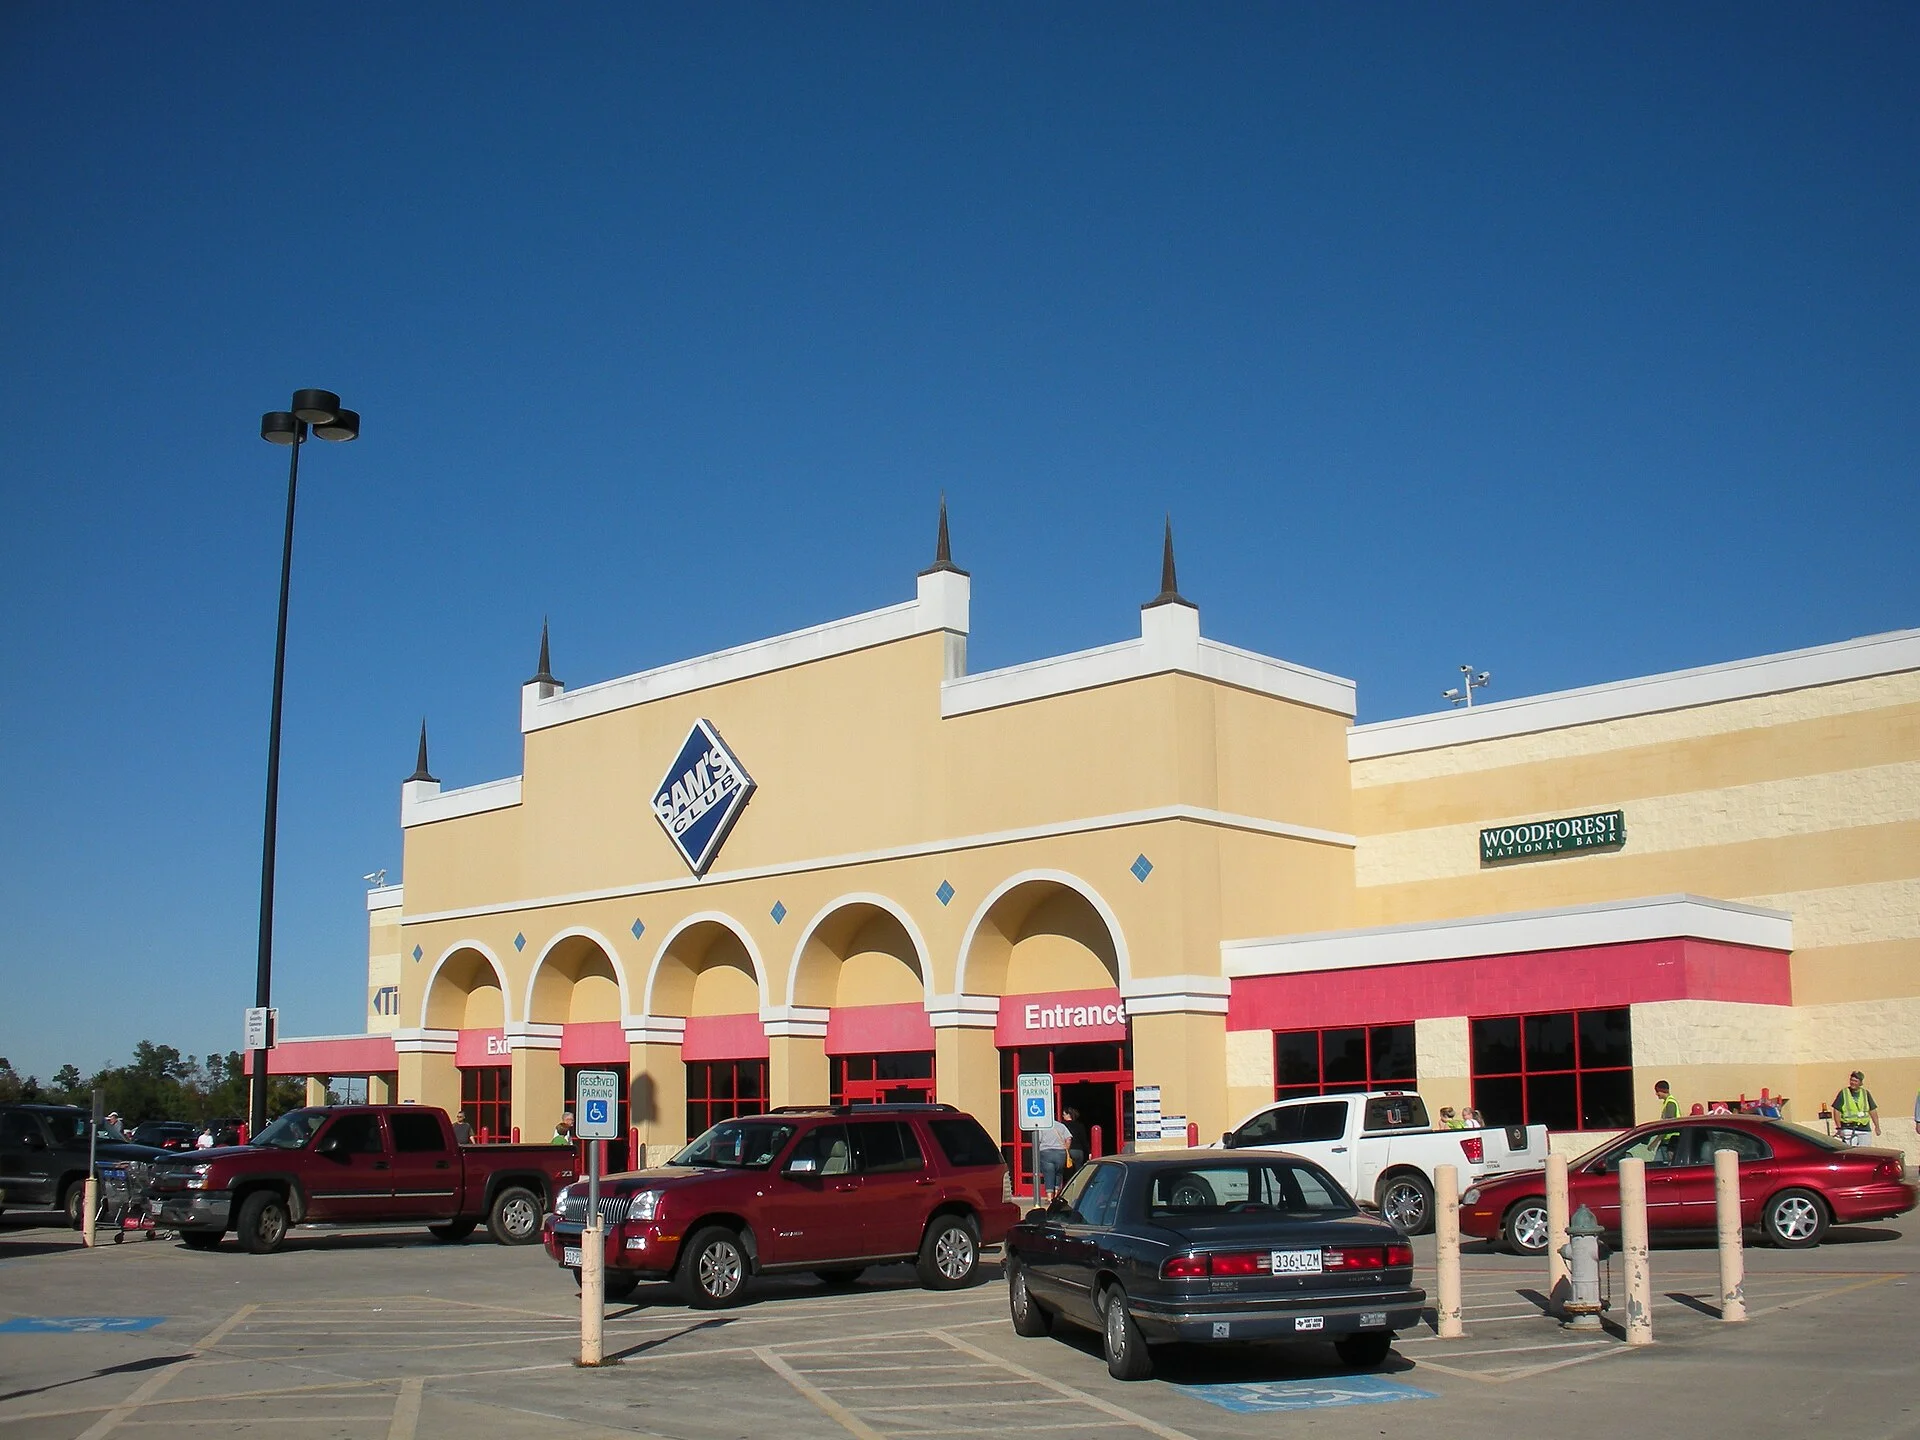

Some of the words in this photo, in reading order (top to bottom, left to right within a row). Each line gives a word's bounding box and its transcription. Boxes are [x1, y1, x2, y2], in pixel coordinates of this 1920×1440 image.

[656, 747, 728, 825] SAM'S
[673, 771, 736, 834] CLUB
[1482, 813, 1618, 848] WOODFOREST
[1485, 841, 1563, 858] NATIONAL
[1576, 832, 1616, 846] BANK
[381, 986, 400, 1015] Ti
[1025, 1003, 1126, 1030] Entrance
[580, 1077, 615, 1087] RESERVED
[582, 1088, 613, 1098] PARKING
[1020, 1079, 1050, 1087] RESERVED
[1022, 1088, 1049, 1096] PARKING
